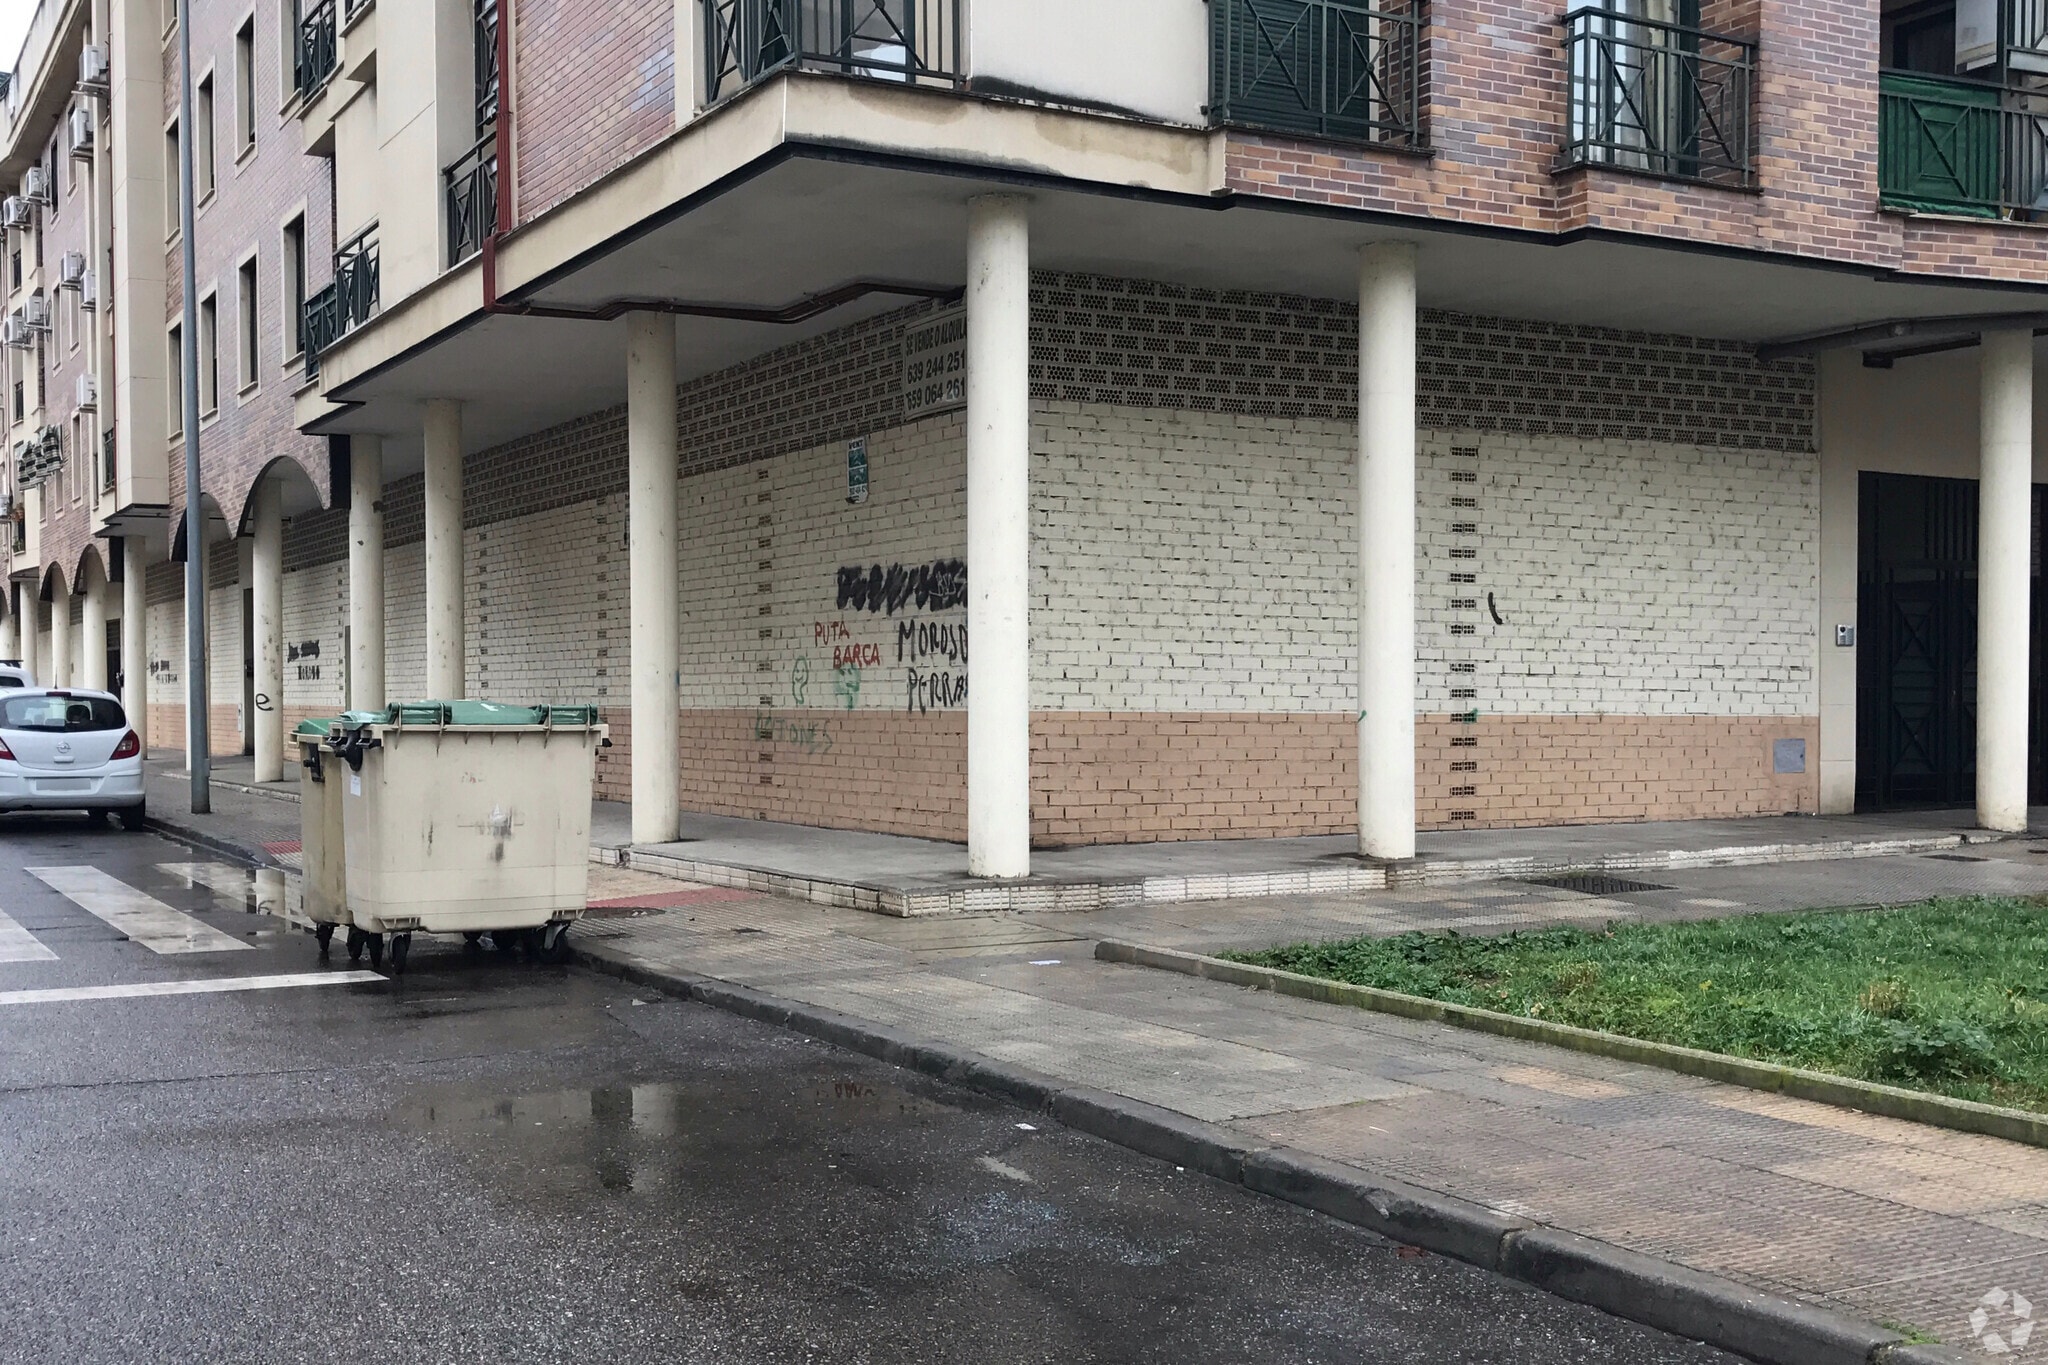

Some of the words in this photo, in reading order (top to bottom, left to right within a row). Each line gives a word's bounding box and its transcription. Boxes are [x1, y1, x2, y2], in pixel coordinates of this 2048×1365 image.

[906, 333, 914, 357] SE
[907, 361, 923, 384] 639
[926, 356, 944, 379] 244
[947, 349, 965, 372] 251
[906, 388, 922, 410] 659
[925, 383, 943, 405] 064
[947, 377, 965, 399] 261
[815, 621, 849, 647] PUTA
[833, 643, 880, 669] BARCA
[908, 667, 968, 717] PERRA
